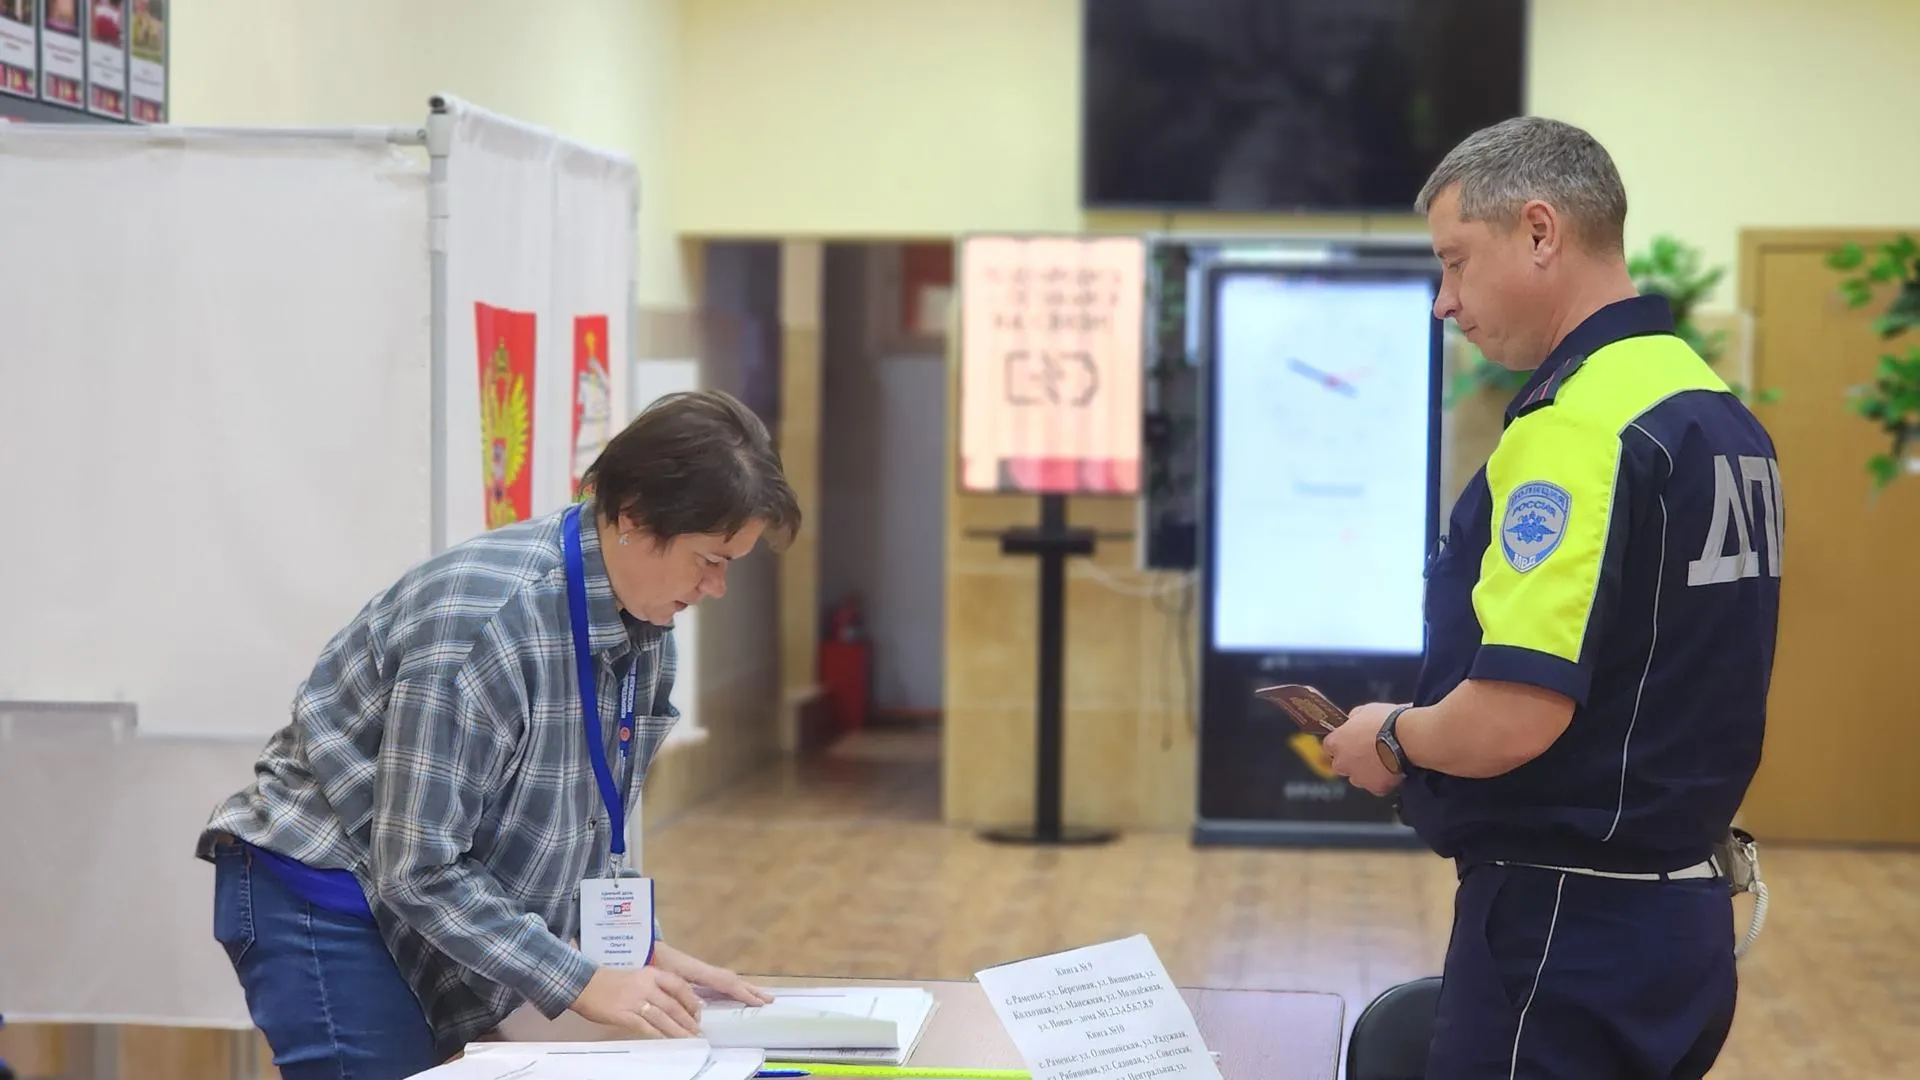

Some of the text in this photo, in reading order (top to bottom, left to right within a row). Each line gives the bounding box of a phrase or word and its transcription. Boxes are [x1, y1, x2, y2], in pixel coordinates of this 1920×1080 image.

[1512, 500, 1557, 518] РОССИЯ
[1055, 966, 1079, 977] Книга
[1038, 1024, 1050, 1033] ул.
[1049, 1015, 1074, 1028] Новая
[1079, 1013, 1096, 1024] дома
[1086, 1030, 1108, 1040] Книга
